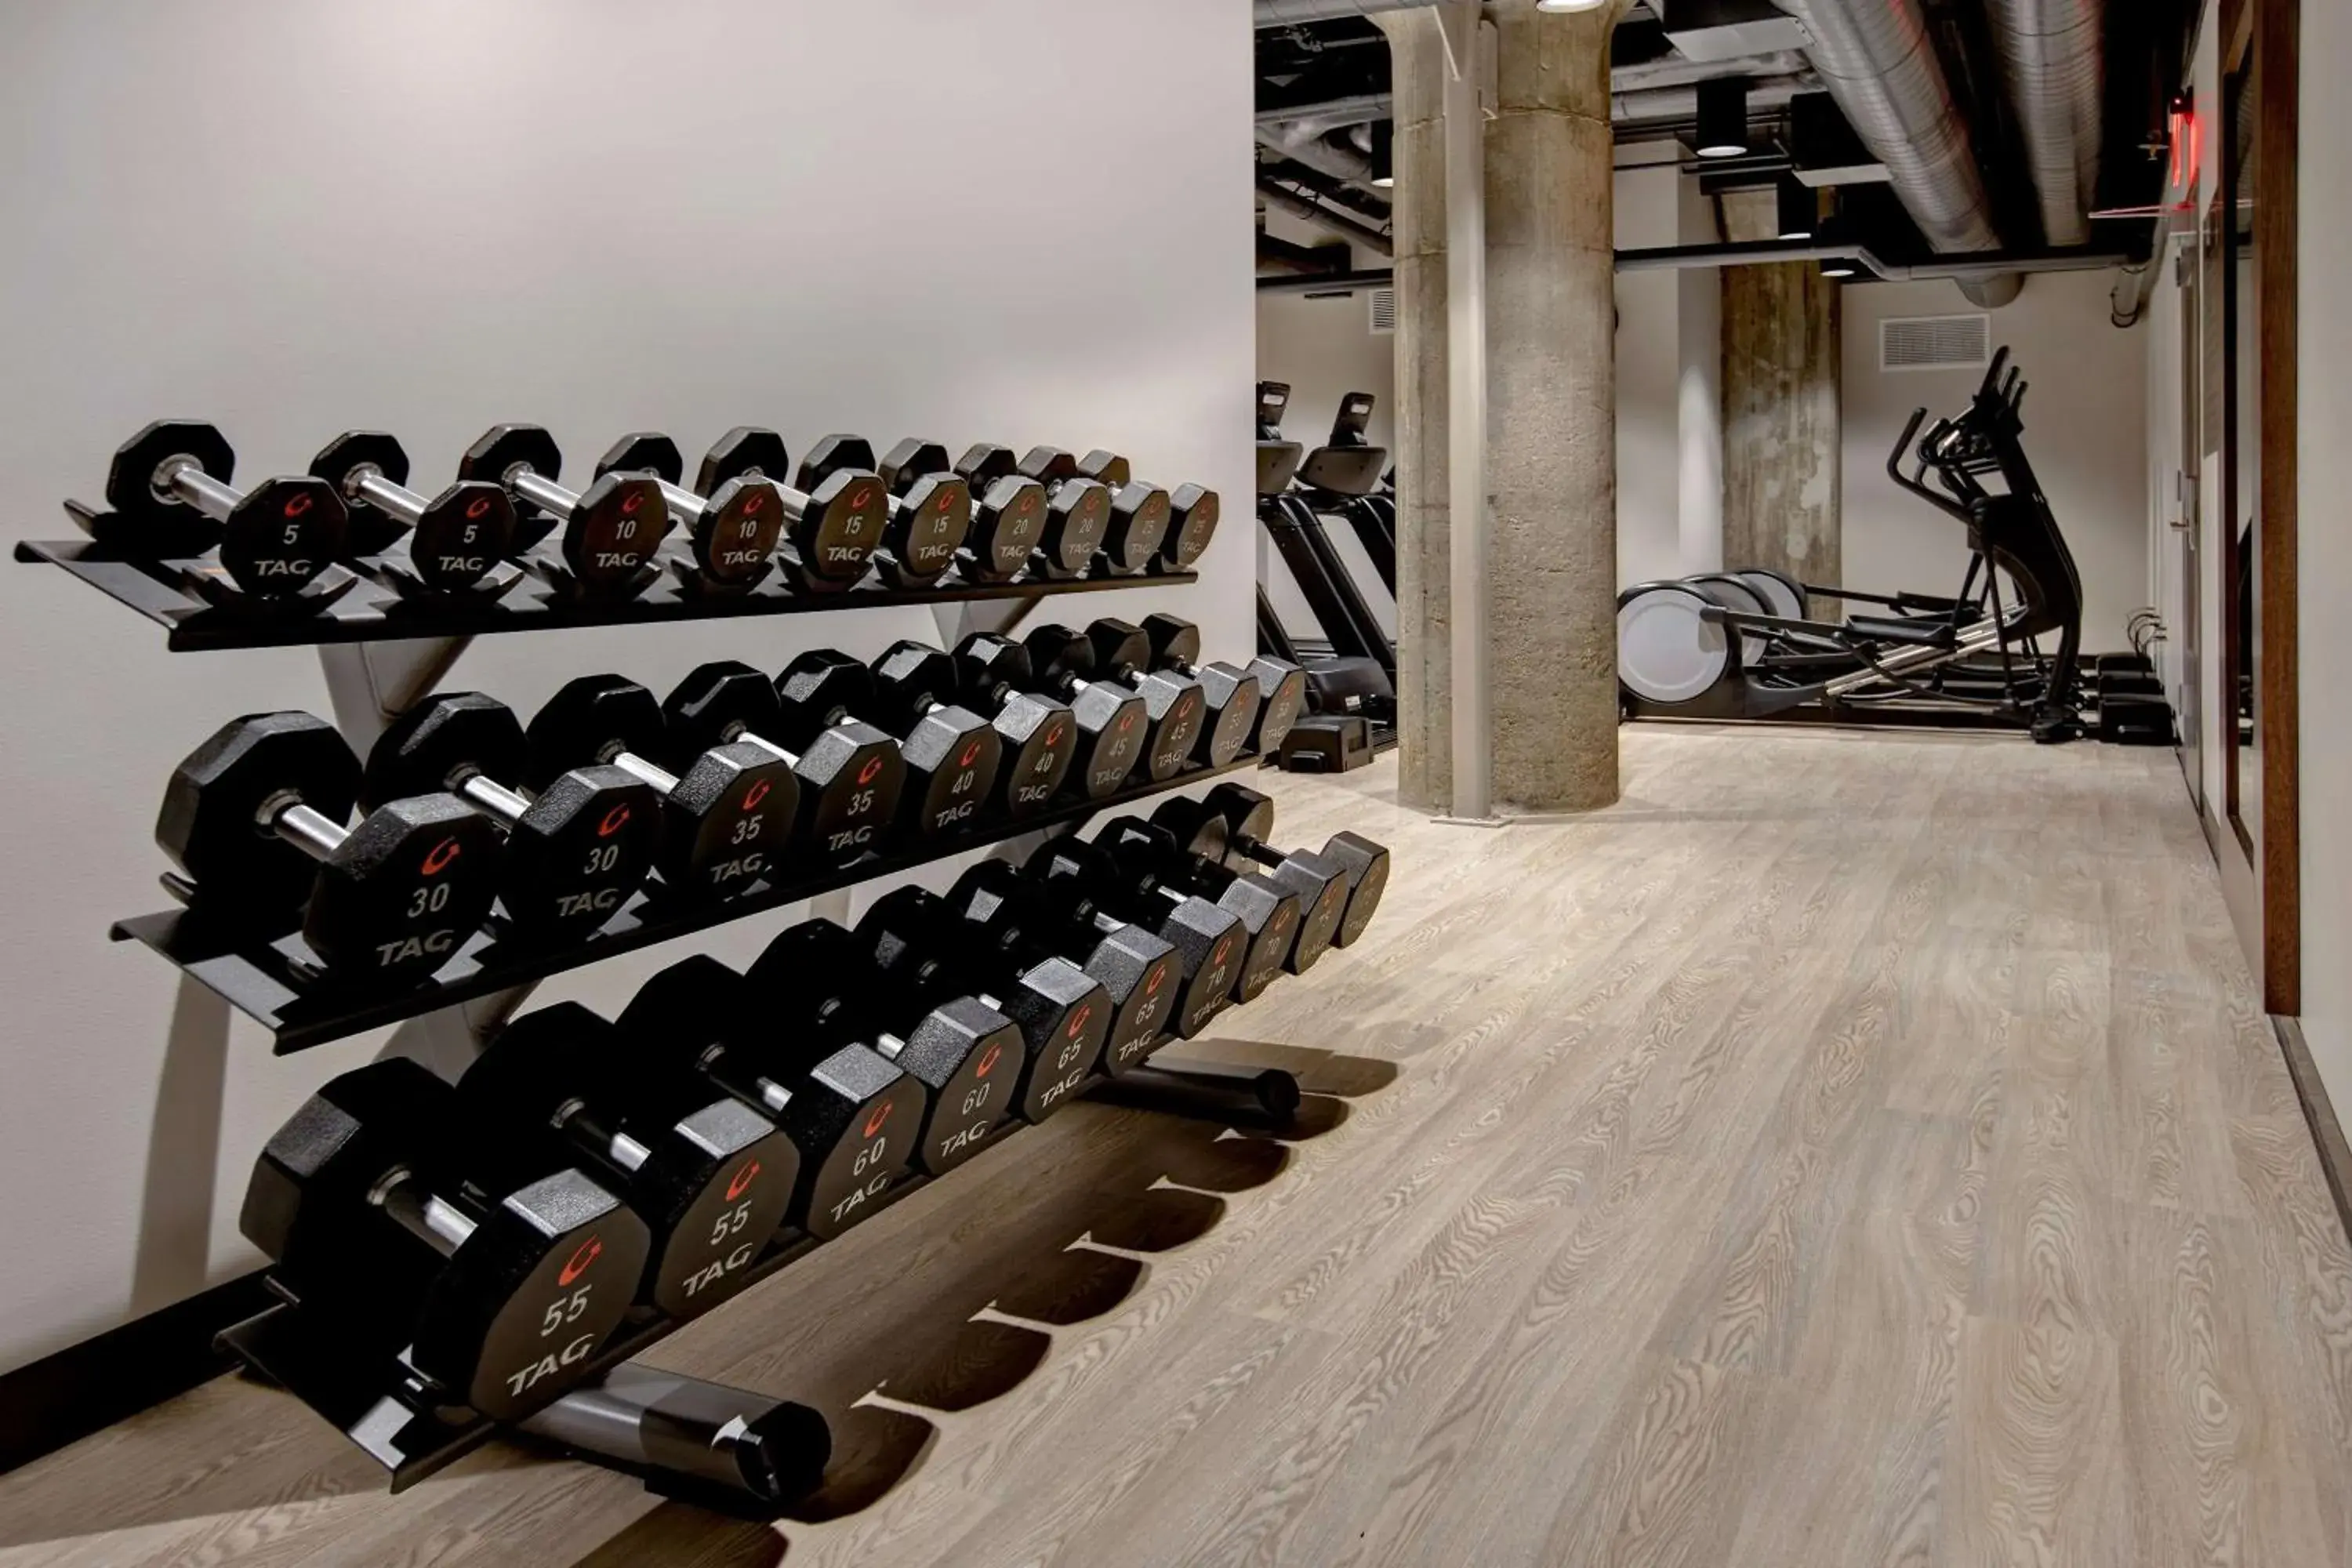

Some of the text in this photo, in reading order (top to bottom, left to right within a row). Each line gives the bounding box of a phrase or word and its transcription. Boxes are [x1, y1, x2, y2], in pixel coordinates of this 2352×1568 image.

[283, 524, 299, 545] 5
[463, 524, 477, 544] 5
[615, 520, 636, 539] 10
[739, 520, 757, 539] 10
[844, 515, 862, 535] 15
[933, 515, 949, 533] 15
[596, 552, 638, 568] TAG
[722, 550, 761, 565] TAG
[827, 547, 863, 561] TAG
[918, 543, 949, 560] TAG
[1000, 545, 1025, 557] TAG
[1068, 542, 1092, 555] TAG
[254, 559, 311, 577] TAG
[439, 556, 483, 572] TAG
[1033, 751, 1054, 774] 40
[1158, 749, 1183, 768] TAG
[951, 770, 975, 795] 40
[1095, 767, 1123, 785] TAG
[847, 790, 874, 816] 35
[1018, 785, 1048, 802] TAG
[935, 800, 975, 828] TAG
[731, 815, 764, 844] 35
[827, 826, 874, 851] TAG
[583, 844, 619, 874] 30
[710, 853, 764, 884] TAG
[407, 883, 449, 918] 30
[556, 888, 619, 916] TAG
[376, 929, 454, 966] TAG
[1248, 967, 1275, 989] TAG
[1135, 996, 1158, 1025] 65
[1192, 990, 1225, 1025] TAG
[1058, 1036, 1084, 1069] 65
[1119, 1029, 1153, 1061] TAG
[962, 1082, 990, 1116] 60
[1041, 1067, 1083, 1108] TAG
[941, 1120, 989, 1158] TAG
[853, 1138, 885, 1176] 60
[830, 1171, 887, 1222] TAG
[710, 1200, 752, 1245] 55
[681, 1243, 753, 1298] TAG
[540, 1284, 592, 1337] 55
[506, 1334, 596, 1397] TAG
